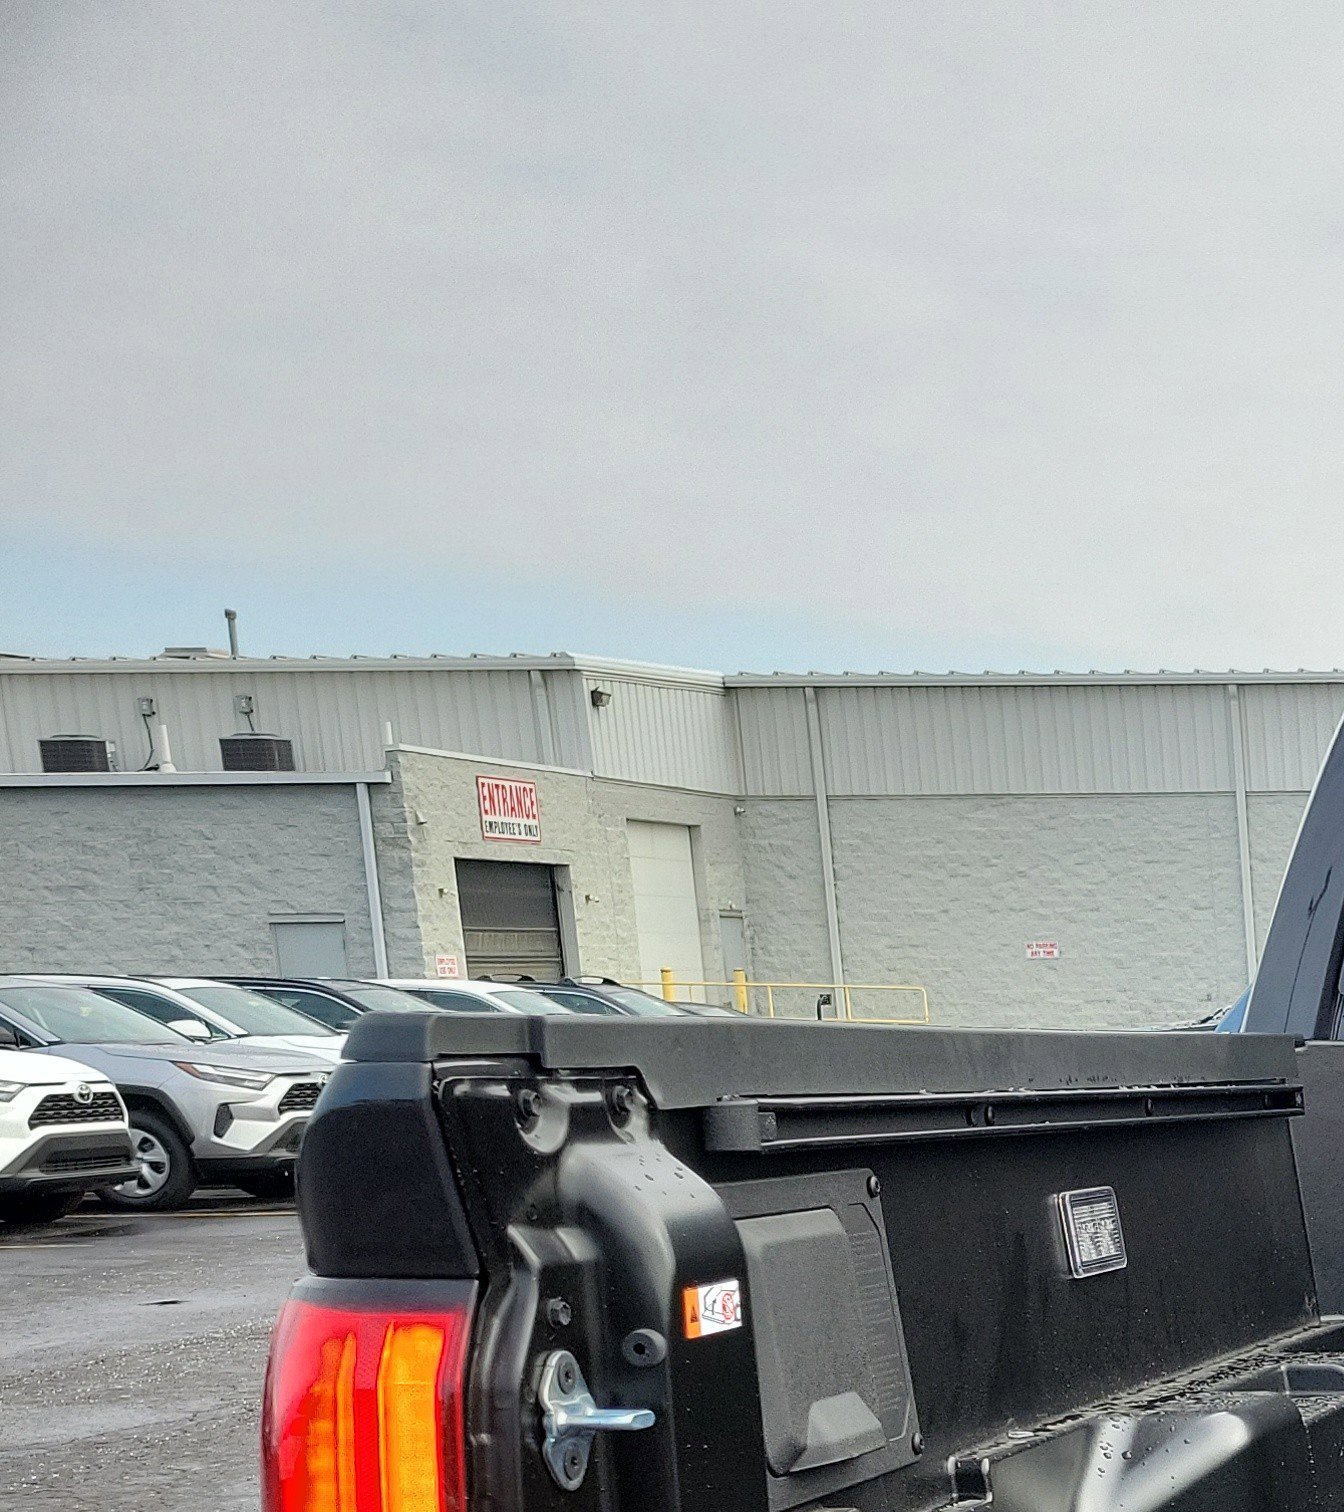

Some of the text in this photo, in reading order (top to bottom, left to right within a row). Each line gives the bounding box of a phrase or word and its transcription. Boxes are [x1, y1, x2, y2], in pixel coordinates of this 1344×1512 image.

[481, 782, 536, 819] ENTRANCE
[485, 820, 539, 837] EMPLOYEE'S ONLY
